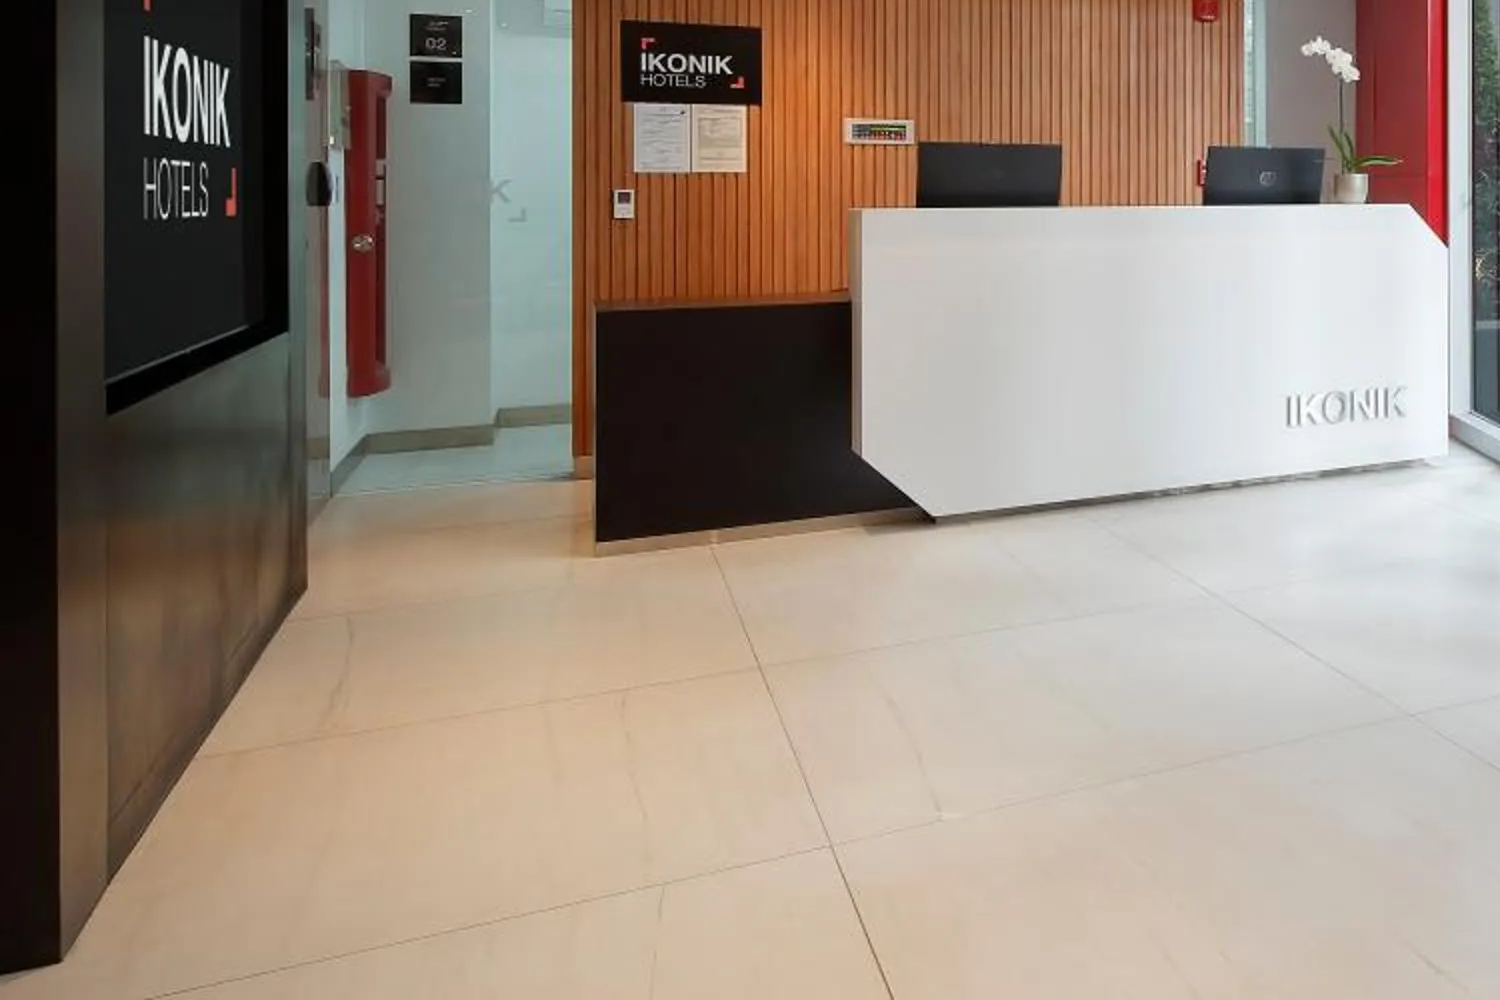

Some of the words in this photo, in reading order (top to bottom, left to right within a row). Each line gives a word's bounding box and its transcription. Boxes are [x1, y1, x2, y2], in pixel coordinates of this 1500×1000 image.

[640, 51, 734, 76] IKONIK
[640, 73, 707, 90] HOTELS
[143, 34, 231, 149] IKONIK
[143, 157, 209, 221] HOTELS
[1285, 385, 1408, 430] IKONIK
